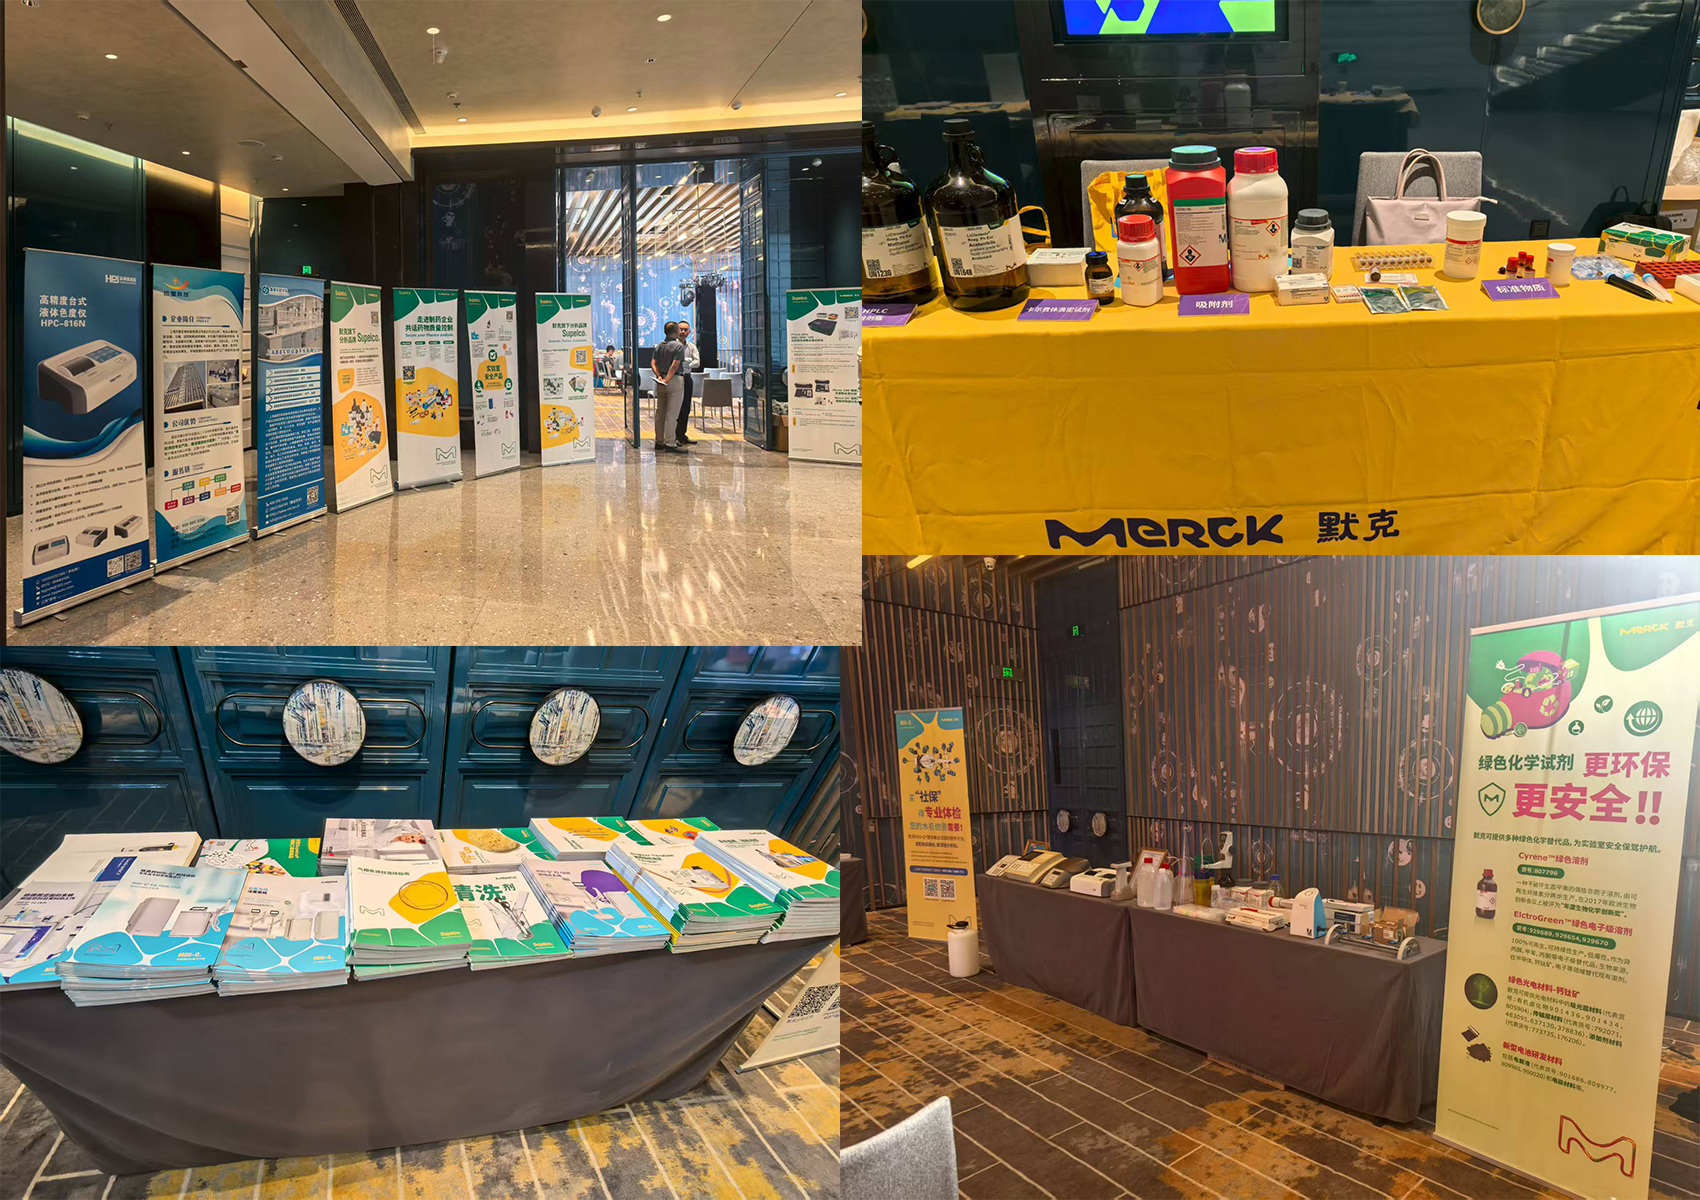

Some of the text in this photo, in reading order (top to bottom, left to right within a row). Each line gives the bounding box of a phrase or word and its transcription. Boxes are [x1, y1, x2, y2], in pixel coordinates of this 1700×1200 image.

[869, 269, 892, 277] UN1230
[1495, 284, 1546, 294] 标准物质
[39, 294, 88, 307] 高精度台式
[1195, 300, 1234, 309] 吸附剂
[39, 307, 88, 319] 液体色度仪
[40, 319, 87, 328] HPC-816N
[416, 315, 453, 324] 走进制药企业
[405, 324, 454, 332] 共话药物质量控制
[562, 329, 588, 338] Supelco.
[357, 332, 381, 344] Supelco.
[1045, 508, 1400, 549] MERCK 默克
[1620, 622, 1669, 637] MERCK
[1478, 750, 1671, 779] 绿色化学试剂 更环保
[1511, 782, 1663, 826] 更安全!!
[1502, 1041, 1563, 1067] 新型电池研发材料
